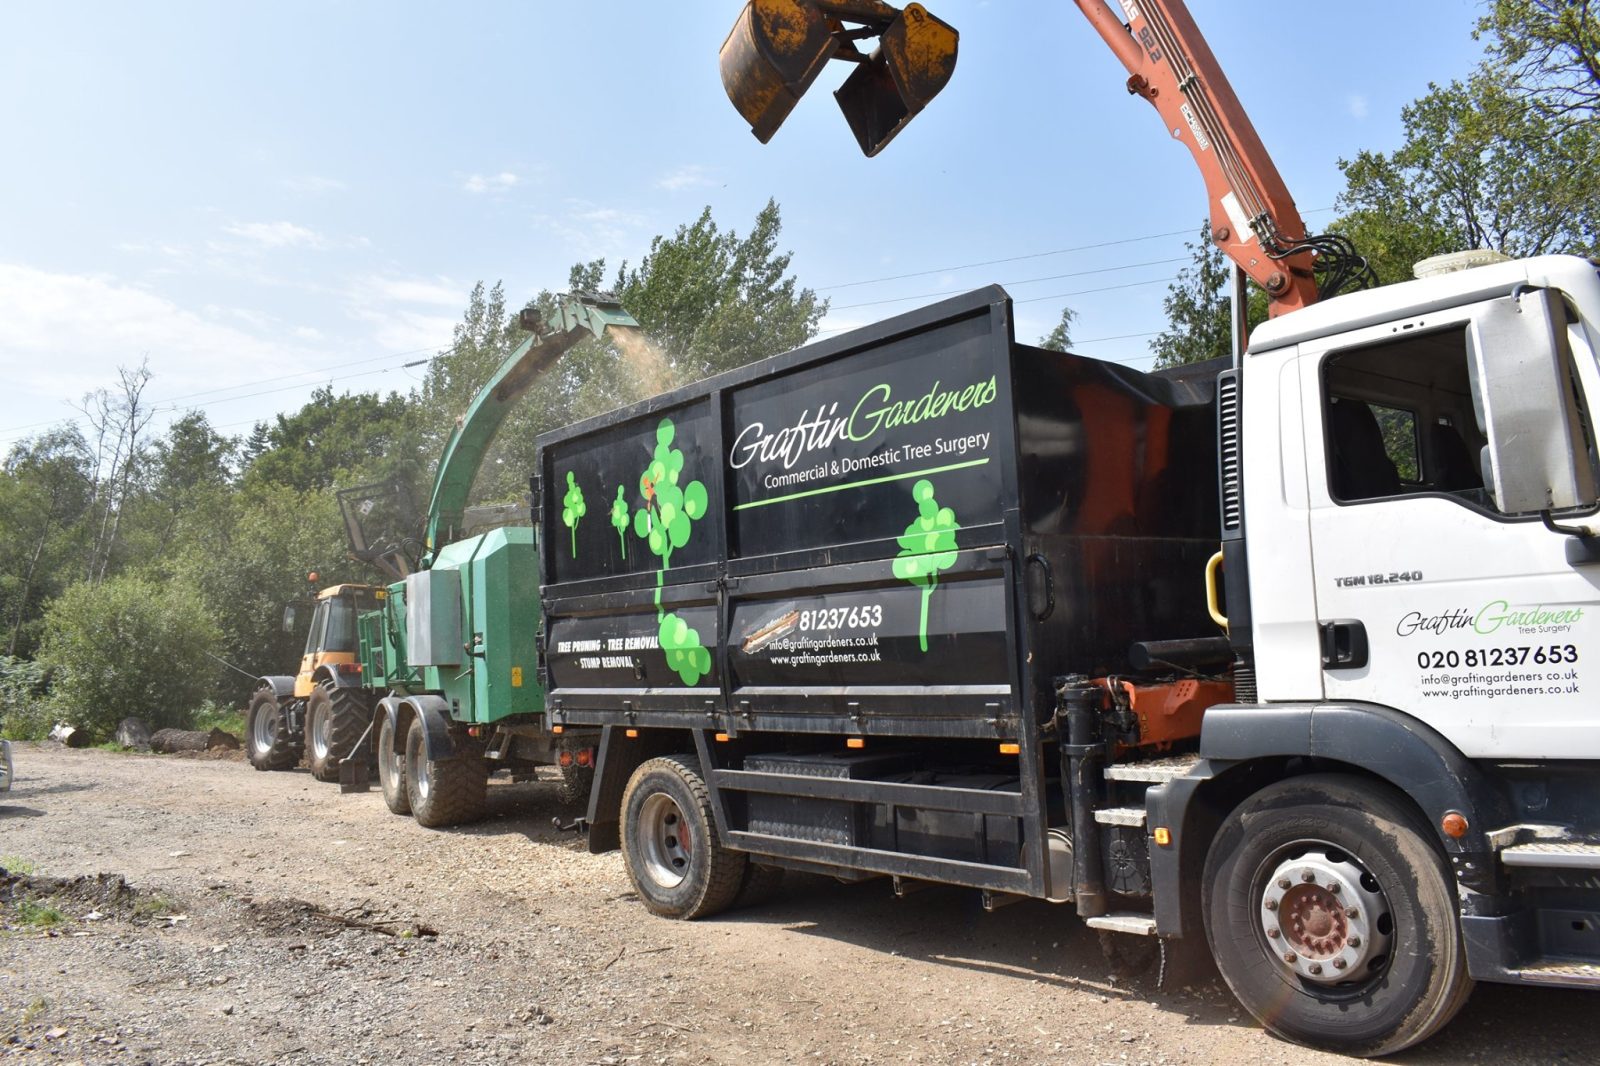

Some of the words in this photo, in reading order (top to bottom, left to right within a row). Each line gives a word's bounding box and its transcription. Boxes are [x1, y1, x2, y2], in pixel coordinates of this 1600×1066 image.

[1119, 0, 1139, 21] AS
[1138, 26, 1162, 64] 92.2
[730, 402, 849, 469] Graftin
[848, 375, 997, 442] Gardeners
[764, 462, 828, 489] Commercial
[830, 460, 840, 474] &
[842, 448, 900, 474] Domestic
[902, 442, 932, 460] Tree
[935, 432, 991, 456] Surgery
[1334, 575, 1366, 588] TGM
[1367, 570, 1423, 585] 18.240
[799, 604, 883, 631] 81237653
[1396, 608, 1475, 637] Graftin
[1474, 600, 1585, 635] Gardeners
[1518, 626, 1537, 634] Tree
[1538, 624, 1572, 634] Surgery
[557, 641, 572, 653] TREE
[572, 639, 601, 652] PRUNING
[607, 638, 624, 651] TREE
[624, 636, 659, 650] REMOVAL
[580, 657, 601, 669] STUMP
[601, 655, 634, 669] REMOVAL
[770, 648, 881, 667] www.graftingardeners.co.uk
[1417, 651, 1460, 669] 020
[1422, 682, 1580, 700] www.graftingardeners.co.uk
